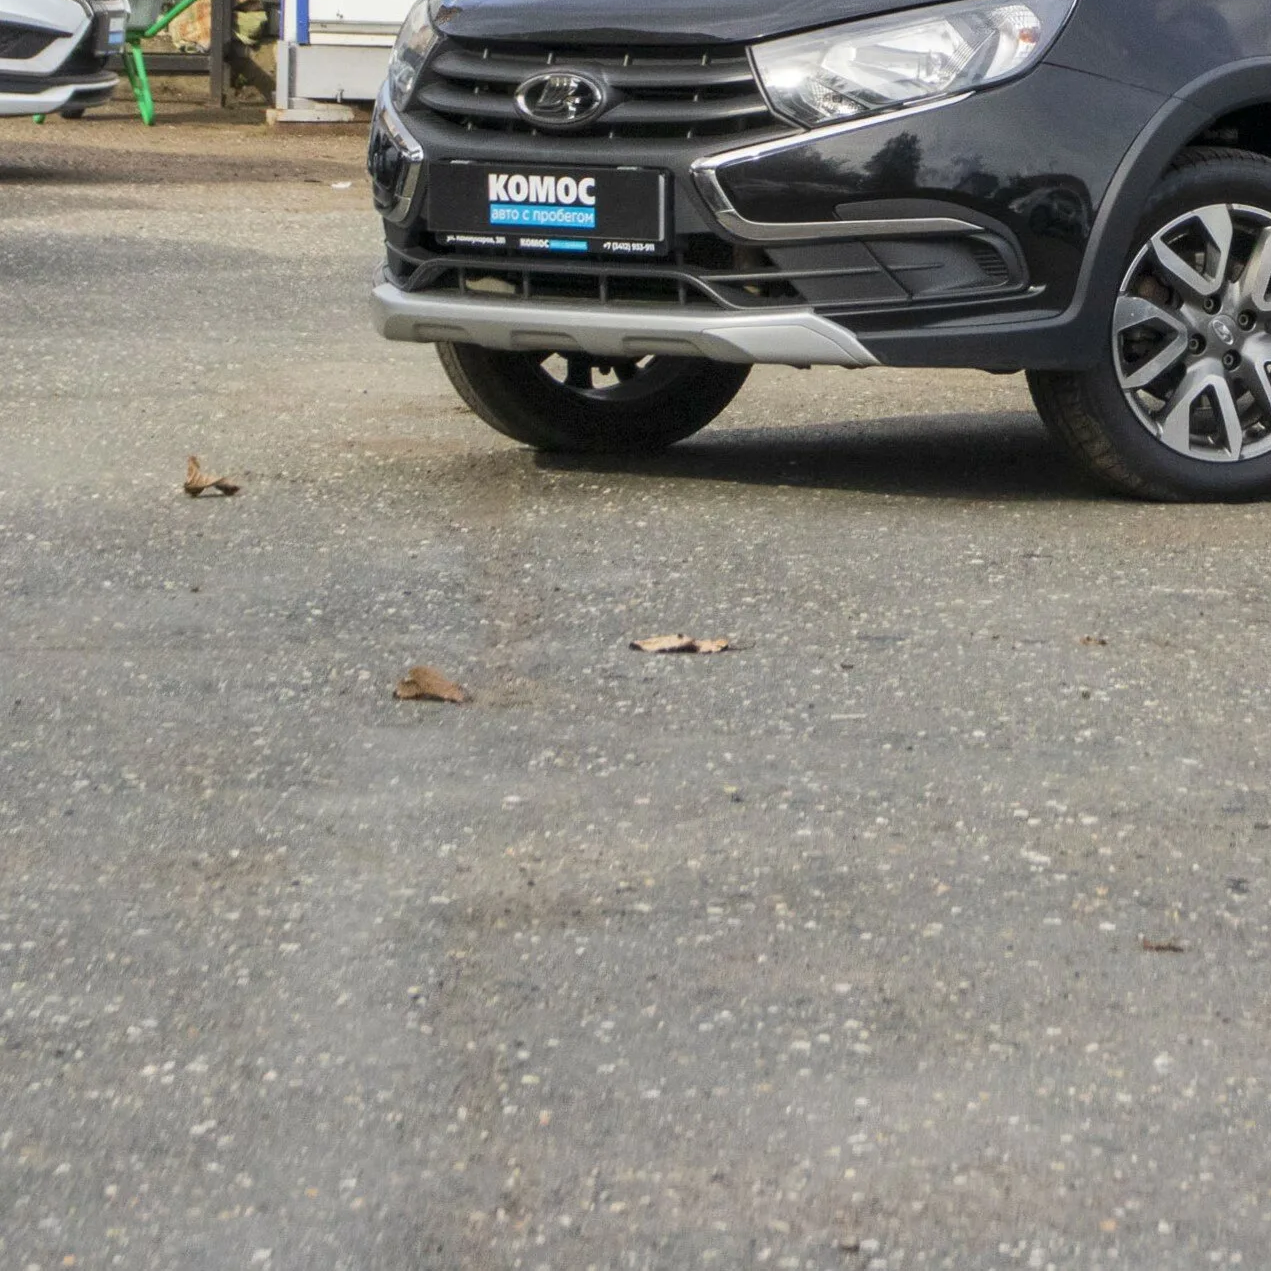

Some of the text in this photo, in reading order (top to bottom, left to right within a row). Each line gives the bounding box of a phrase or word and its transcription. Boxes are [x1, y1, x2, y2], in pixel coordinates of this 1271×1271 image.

[488, 173, 596, 205] КОМОС
[491, 208, 595, 225] авто с пробегом
